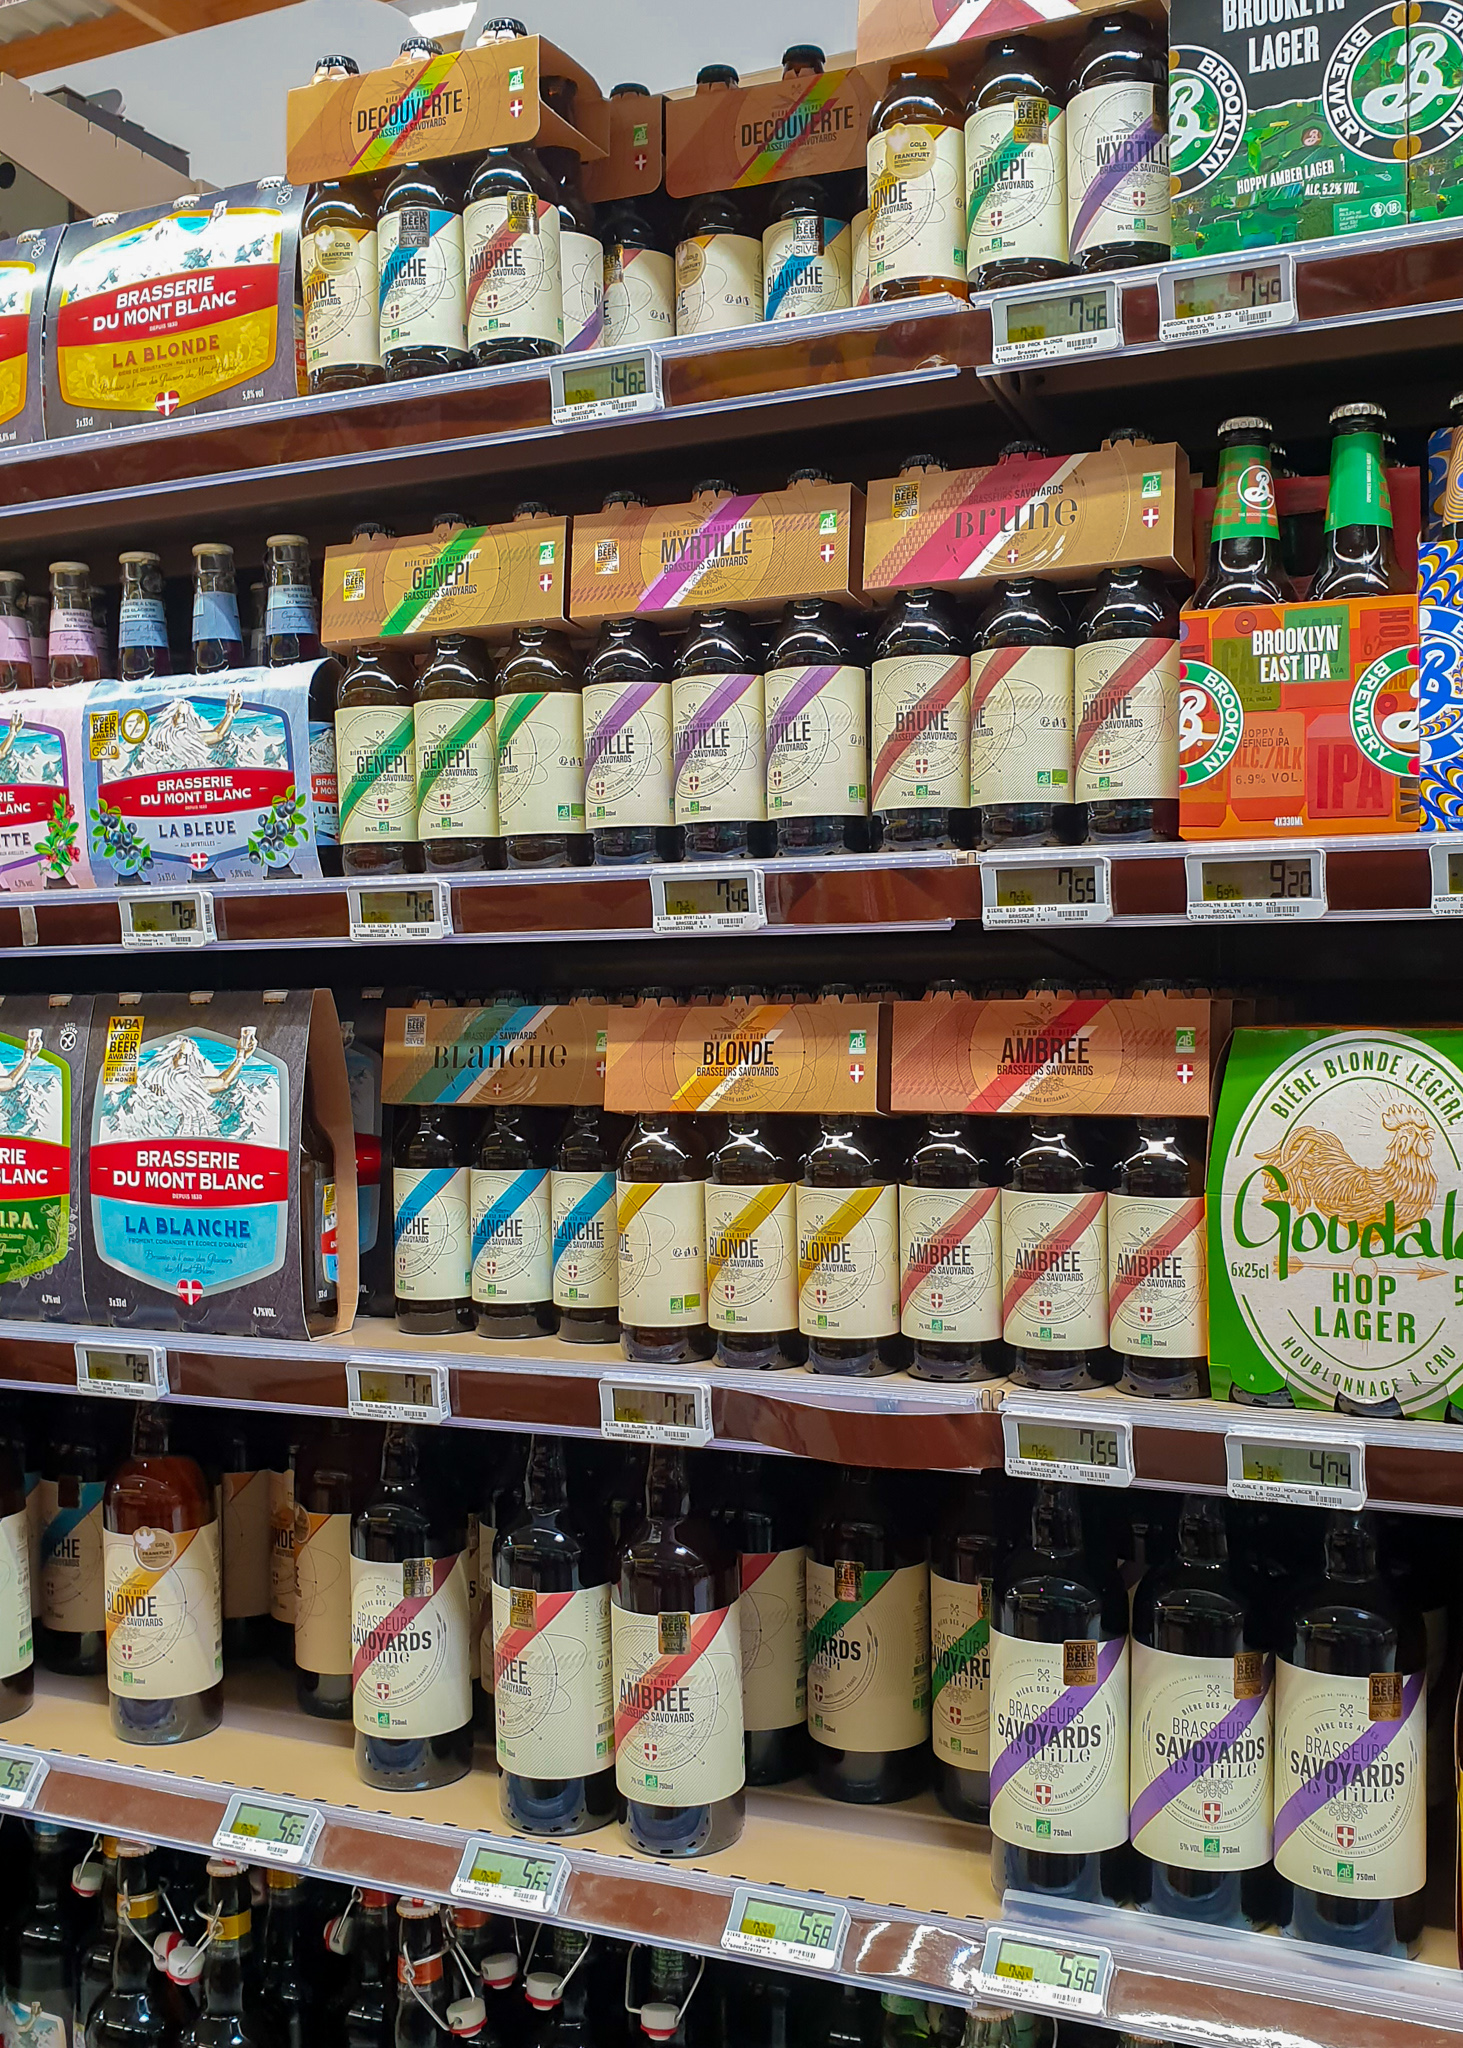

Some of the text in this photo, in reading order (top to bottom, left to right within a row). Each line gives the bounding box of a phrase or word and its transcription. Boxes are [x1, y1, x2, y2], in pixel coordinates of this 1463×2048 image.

[1249, 26, 1320, 74] LAGER
[1329, 26, 1374, 149] BREWERY
[357, 89, 463, 133] DECOUVERTE
[1197, 55, 1240, 176] BROOKLYN
[410, 117, 446, 134] SAVOYARDS
[741, 105, 854, 147] DECOUVERTE
[894, 152, 930, 160] FRANKFURT
[973, 158, 1025, 190] GENEPI
[1237, 159, 1334, 195] HOPPY AMBER LAGER
[996, 180, 1034, 192] SAVOYARDS
[1305, 182, 1360, 195] ALC. 5.2% VOL.
[400, 236, 429, 246] SILVER
[469, 248, 523, 276] AMBREE
[768, 267, 823, 293] BLANCHE
[116, 276, 215, 310] BRASSERIE
[92, 290, 237, 332] DU MONT BLANC
[112, 352, 136, 369] LA
[143, 334, 221, 364] BLONDE
[894, 491, 917, 500] BEER
[1015, 485, 1064, 499] SAVOYARDS
[893, 508, 918, 519] GOLD
[597, 548, 617, 557] BEER
[660, 530, 752, 563] MYRTILLE
[664, 555, 748, 574] BRASSEURS SAVOYARDS
[345, 578, 364, 586] BEER
[412, 562, 469, 590] GENEPI
[403, 585, 477, 601] BRASSEURS SAVOYARDS
[1252, 624, 1339, 656] BROOKLYN
[1260, 654, 1331, 683] EAST IPA
[1083, 696, 1132, 722] BRUNE
[1353, 660, 1392, 761] BREWERY
[92, 722, 116, 733] BEER
[896, 710, 949, 732] BRUNE
[1203, 672, 1239, 773] BROOKLYN
[92, 731, 117, 740] AWARDS
[923, 731, 957, 741] SAVOYARDS
[1276, 738, 1289, 747] IPA
[92, 746, 117, 758] GOLD
[423, 749, 470, 769] GENEPI
[356, 755, 408, 774] GENEPI
[157, 776, 233, 791] BRASSERIE
[383, 774, 414, 782] SAVOYARDS
[1235, 772, 1303, 785] 6.9% VOL.
[1316, 742, 1384, 810] IPA
[140, 788, 251, 806] DU MONT BLANC
[159, 820, 236, 839] LA BLEUE
[112, 1018, 141, 1031] WBA
[110, 1033, 140, 1042] WORLD
[499, 1031, 537, 1040] SAVOYARDS
[108, 1051, 138, 1061] AWARDS
[109, 1040, 138, 1053] BEER
[703, 1041, 775, 1066] BLONDE
[1001, 1037, 1090, 1064] AMBREE
[697, 1066, 779, 1077] BRASSEURS SAVOYARDS
[996, 1065, 1093, 1076] BRASSEURS SAVOYARDS
[1270, 1069, 1322, 1120] BIÈRE
[1324, 1050, 1404, 1076] BLONDE
[136, 1150, 240, 1170] BRASSERIE
[113, 1171, 264, 1190] DU MONT BLANC
[125, 1215, 250, 1238] LA BLANCHE
[472, 1219, 523, 1238] BLANCHE
[709, 1237, 759, 1259] BLONDE
[800, 1240, 851, 1263] BLONDE
[909, 1241, 971, 1266] AMBREE
[1015, 1248, 1080, 1272] AMBREE
[1117, 1254, 1182, 1279] AMBREE
[938, 1265, 974, 1276] SAVOYARDS
[1046, 1272, 1083, 1283] SAVOYARDS
[1231, 1262, 1269, 1280] 6x25cl
[1147, 1278, 1186, 1289] SAVOYARDS
[1332, 1272, 1397, 1306] HOP
[1314, 1306, 1416, 1344] LAGER
[1281, 1335, 1458, 1397] HOUBLONNAGE À CRU
[404, 1568, 431, 1577] BEER
[106, 1596, 157, 1617] BLONDE
[511, 1599, 533, 1609] BEER
[357, 1611, 415, 1631] BRASSEURS
[661, 1622, 687, 1632] BEER
[353, 1629, 432, 1651] SAVOYARDS
[1066, 1644, 1095, 1652] WORLD
[1066, 1652, 1095, 1662] BEER
[1066, 1674, 1096, 1683] BRONZE
[620, 1679, 690, 1712] AMBREE
[1016, 1686, 1051, 1698] BIÈRE DES
[1372, 1685, 1400, 1696] BEER
[651, 1712, 694, 1723] SAVOYARDS
[1009, 1699, 1084, 1724] BRASSEURS
[1182, 1701, 1220, 1715] BIÈRE DES
[998, 1713, 1101, 1747] SAVOYARDS
[1172, 1717, 1252, 1739] BRASSEURS
[1314, 1721, 1353, 1735] BIÈRE DES
[1155, 1733, 1265, 1764] SAVOYARDS
[1305, 1735, 1389, 1762] BRASSEURS
[1290, 1750, 1405, 1787] SAVOYARDS
[1053, 1829, 1072, 1837] 750ml
[1222, 1846, 1240, 1854] 750ml
[1312, 1865, 1376, 1881] 5% 750ml
